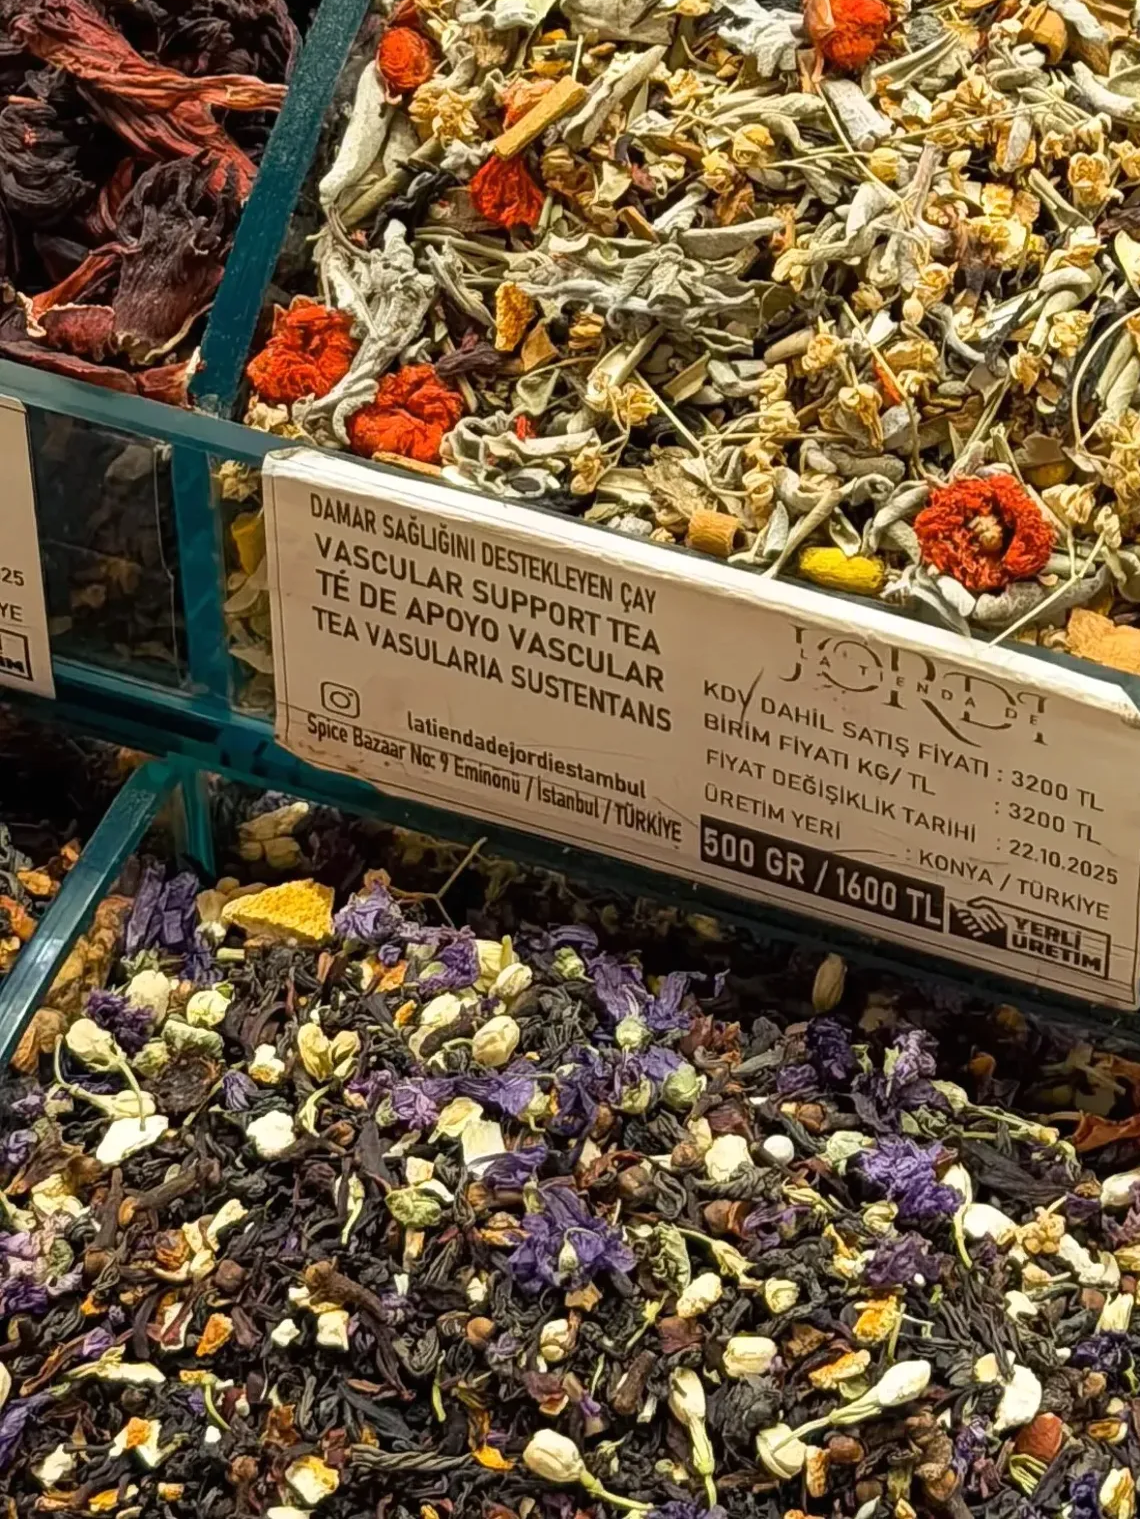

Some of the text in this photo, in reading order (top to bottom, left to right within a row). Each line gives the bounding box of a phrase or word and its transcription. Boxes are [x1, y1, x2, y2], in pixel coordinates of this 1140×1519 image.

[310, 494, 656, 614] DAMAR SAĞLIĞINI DESTEKLEYEN ÇAY
[314, 533, 661, 655] VASCULAR SUPPORT TEA
[312, 606, 672, 732] TEA VASULARIA SUSTENTANS
[316, 569, 664, 692] TÉ DE APOYO VASCULAR
[307, 713, 348, 742] Spice
[352, 727, 404, 760] Bazaar
[440, 753, 448, 772] 9
[615, 803, 682, 843] TÜRKİYE
[408, 711, 646, 800] latiendadejordiestambul
[704, 679, 1104, 812] KDV DAHİL SATIŞ FİYATI 3200 TL
[704, 712, 1101, 845] BİRİM FİYATI KG/ TL 3200 TL
[704, 783, 1110, 921] ÜRETİM YERİ KONYA TÜRKİYE
[704, 826, 941, 926] 500 GR 1600 TL
[706, 748, 1118, 885] FİYAT DEĞİŞİKLİK TARİHİ 22.10.2025
[1013, 916, 1082, 948] YERLİ
